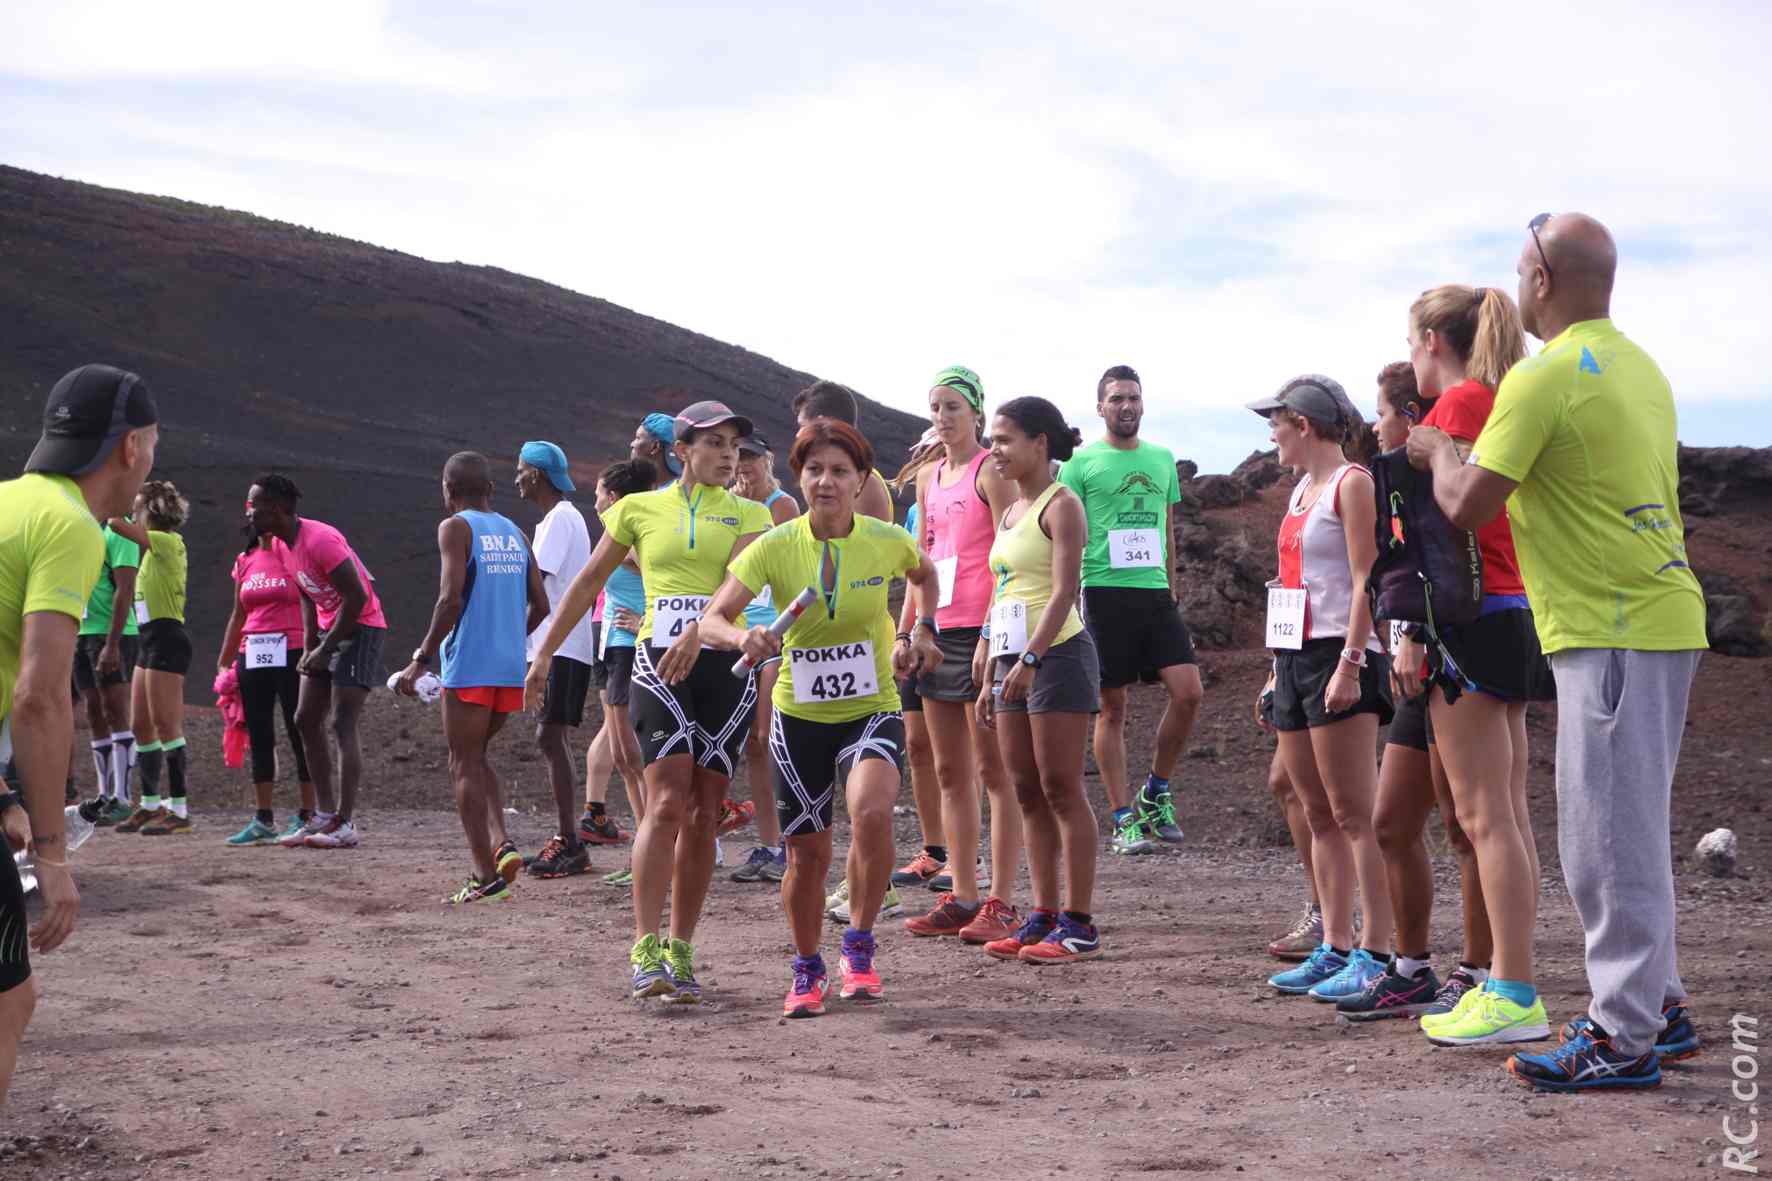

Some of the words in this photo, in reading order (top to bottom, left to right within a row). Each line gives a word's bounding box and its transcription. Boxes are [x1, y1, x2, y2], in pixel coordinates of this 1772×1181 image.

[503, 552, 524, 562] PAUL
[1126, 550, 1151, 561] 341
[1273, 622, 1295, 636] 1122
[255, 653, 274, 665] 952
[791, 643, 867, 664] POKKA
[811, 671, 858, 700] 432
